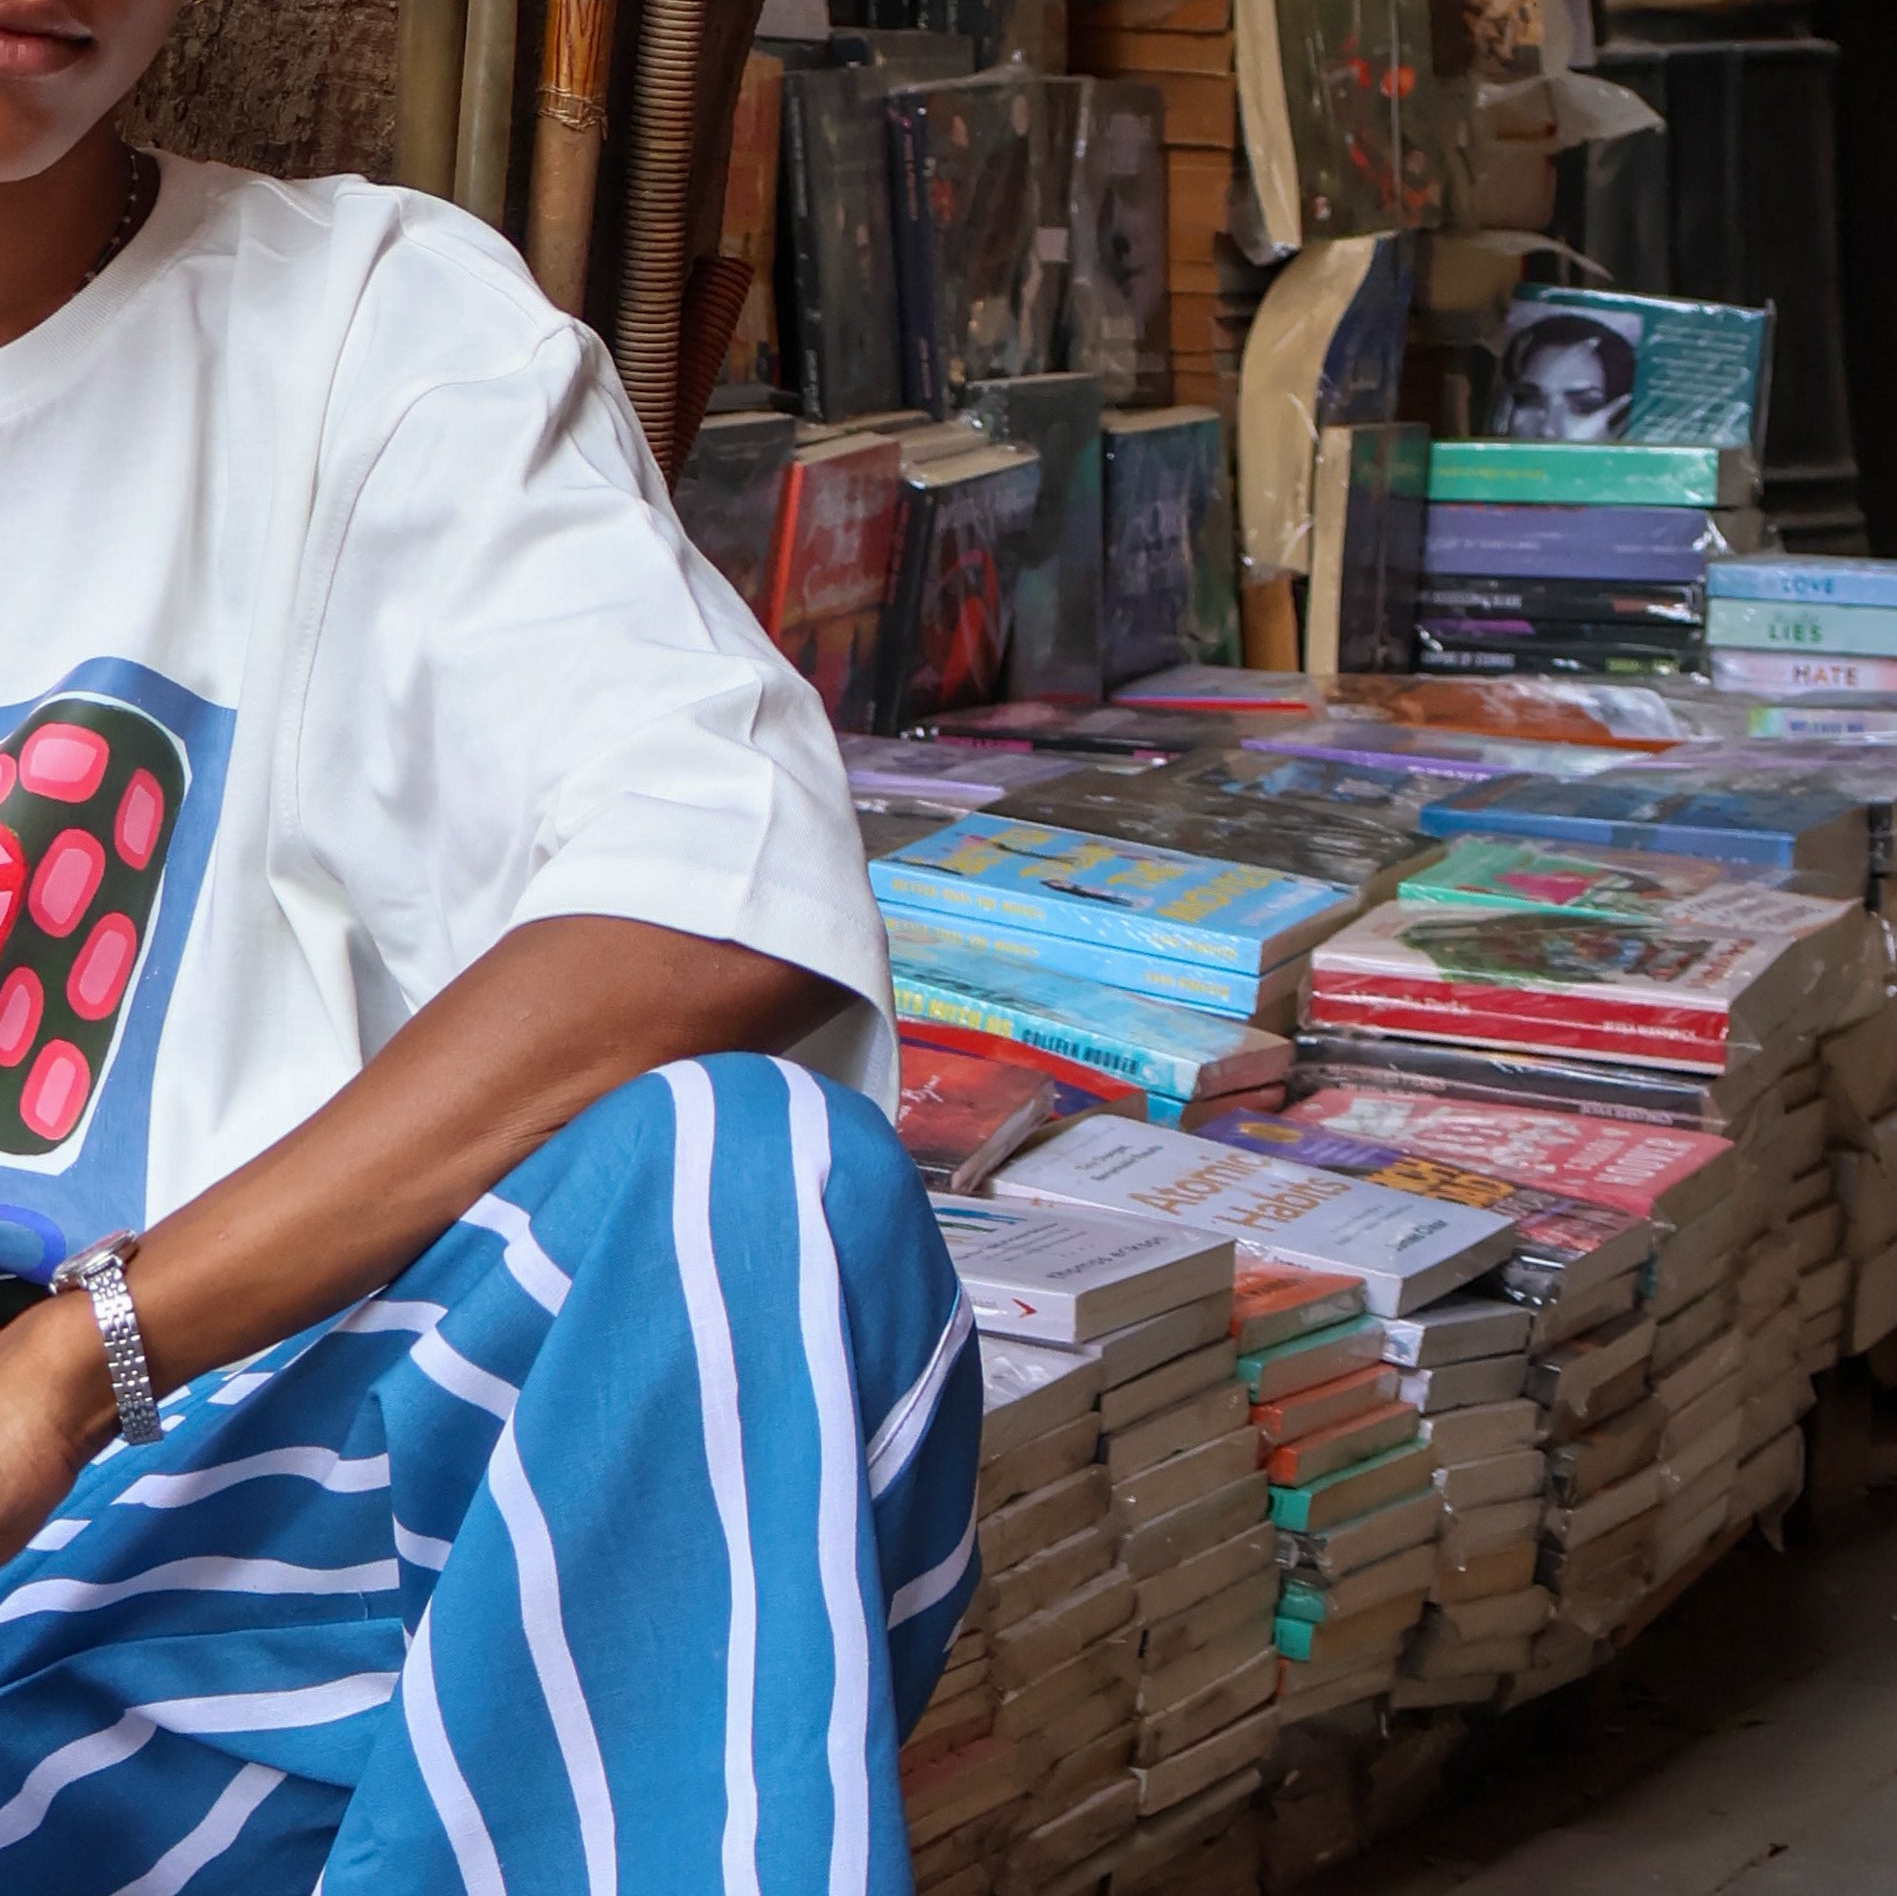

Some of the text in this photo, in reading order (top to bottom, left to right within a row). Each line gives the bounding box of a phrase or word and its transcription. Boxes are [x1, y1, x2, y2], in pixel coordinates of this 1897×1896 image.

[1768, 620, 1824, 644] LIES
[1791, 664, 1859, 689] HATE
[1127, 1152, 1274, 1216] Atomic
[1211, 1174, 1353, 1233] Habits
